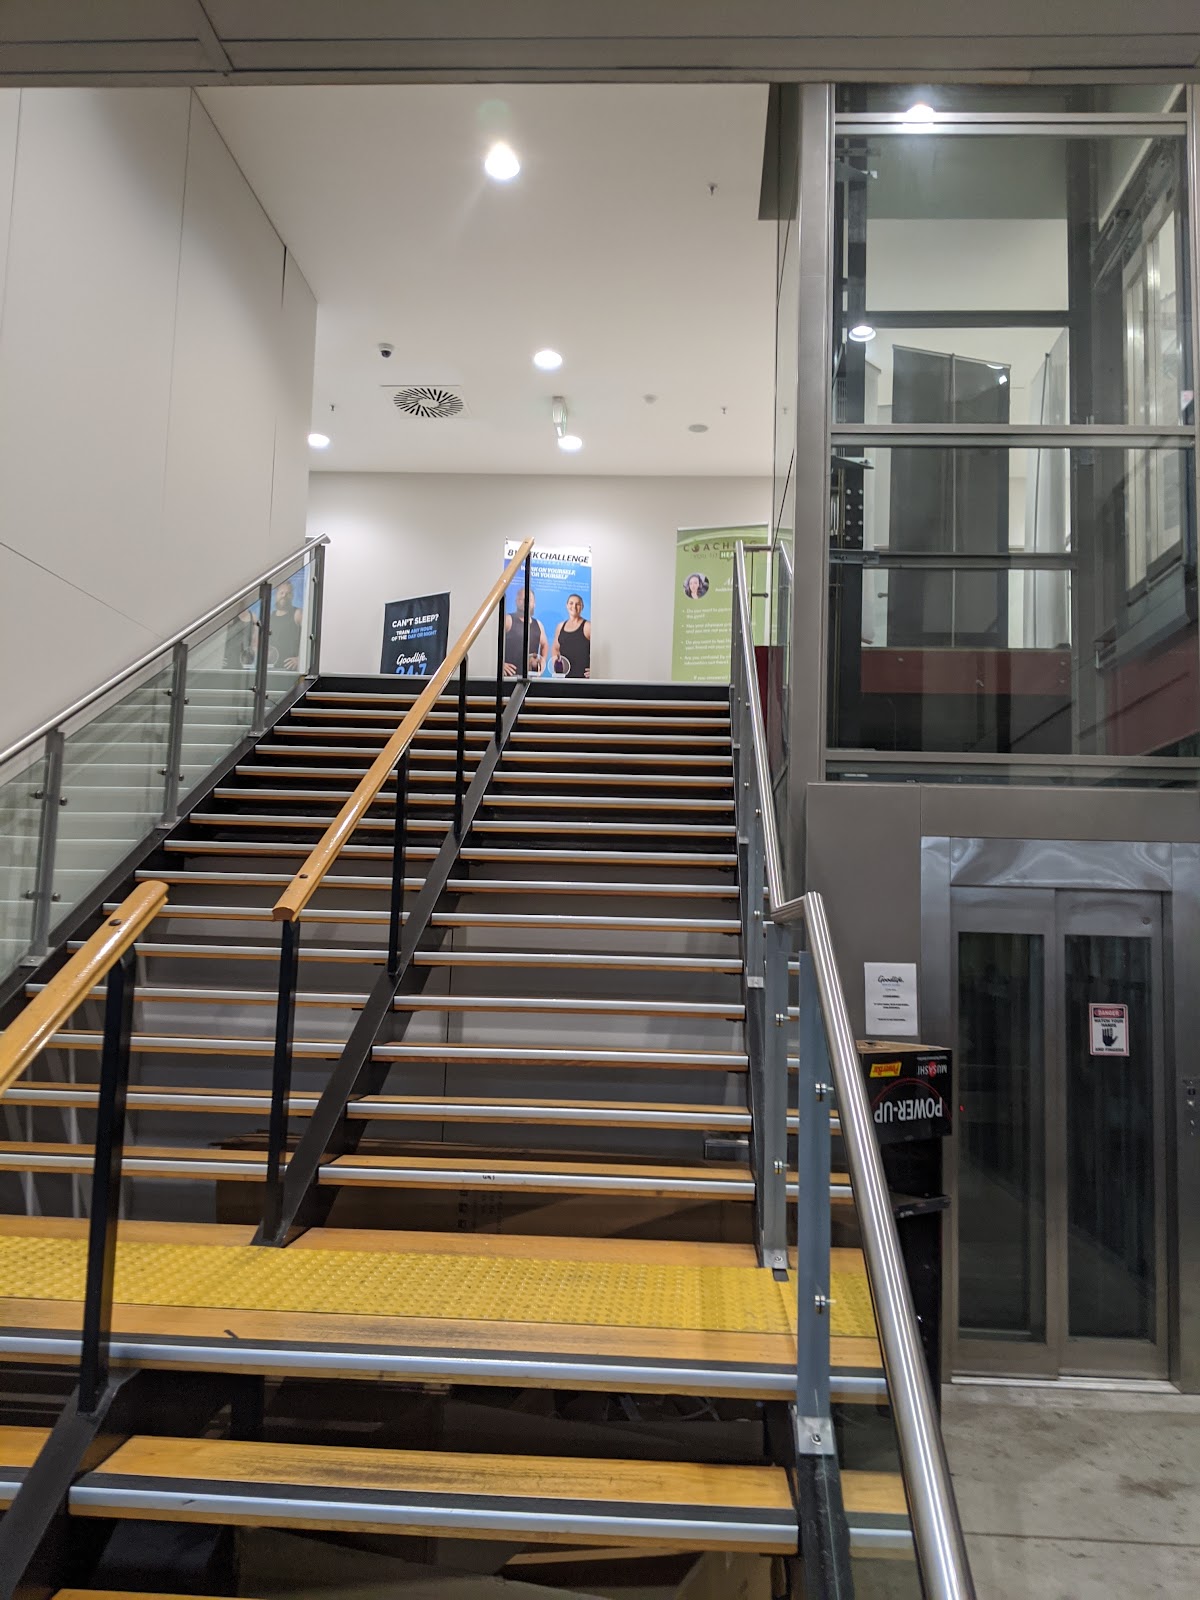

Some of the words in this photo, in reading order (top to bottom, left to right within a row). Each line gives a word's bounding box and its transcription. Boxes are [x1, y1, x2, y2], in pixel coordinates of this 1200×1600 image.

[508, 549, 514, 557] 8
[539, 552, 590, 564] CHALLENGE
[392, 618, 414, 628] CAN'T
[414, 613, 440, 625] SLEEP?
[917, 1064, 948, 1076] MUSASHI
[873, 1096, 943, 1124] POWER-UP
